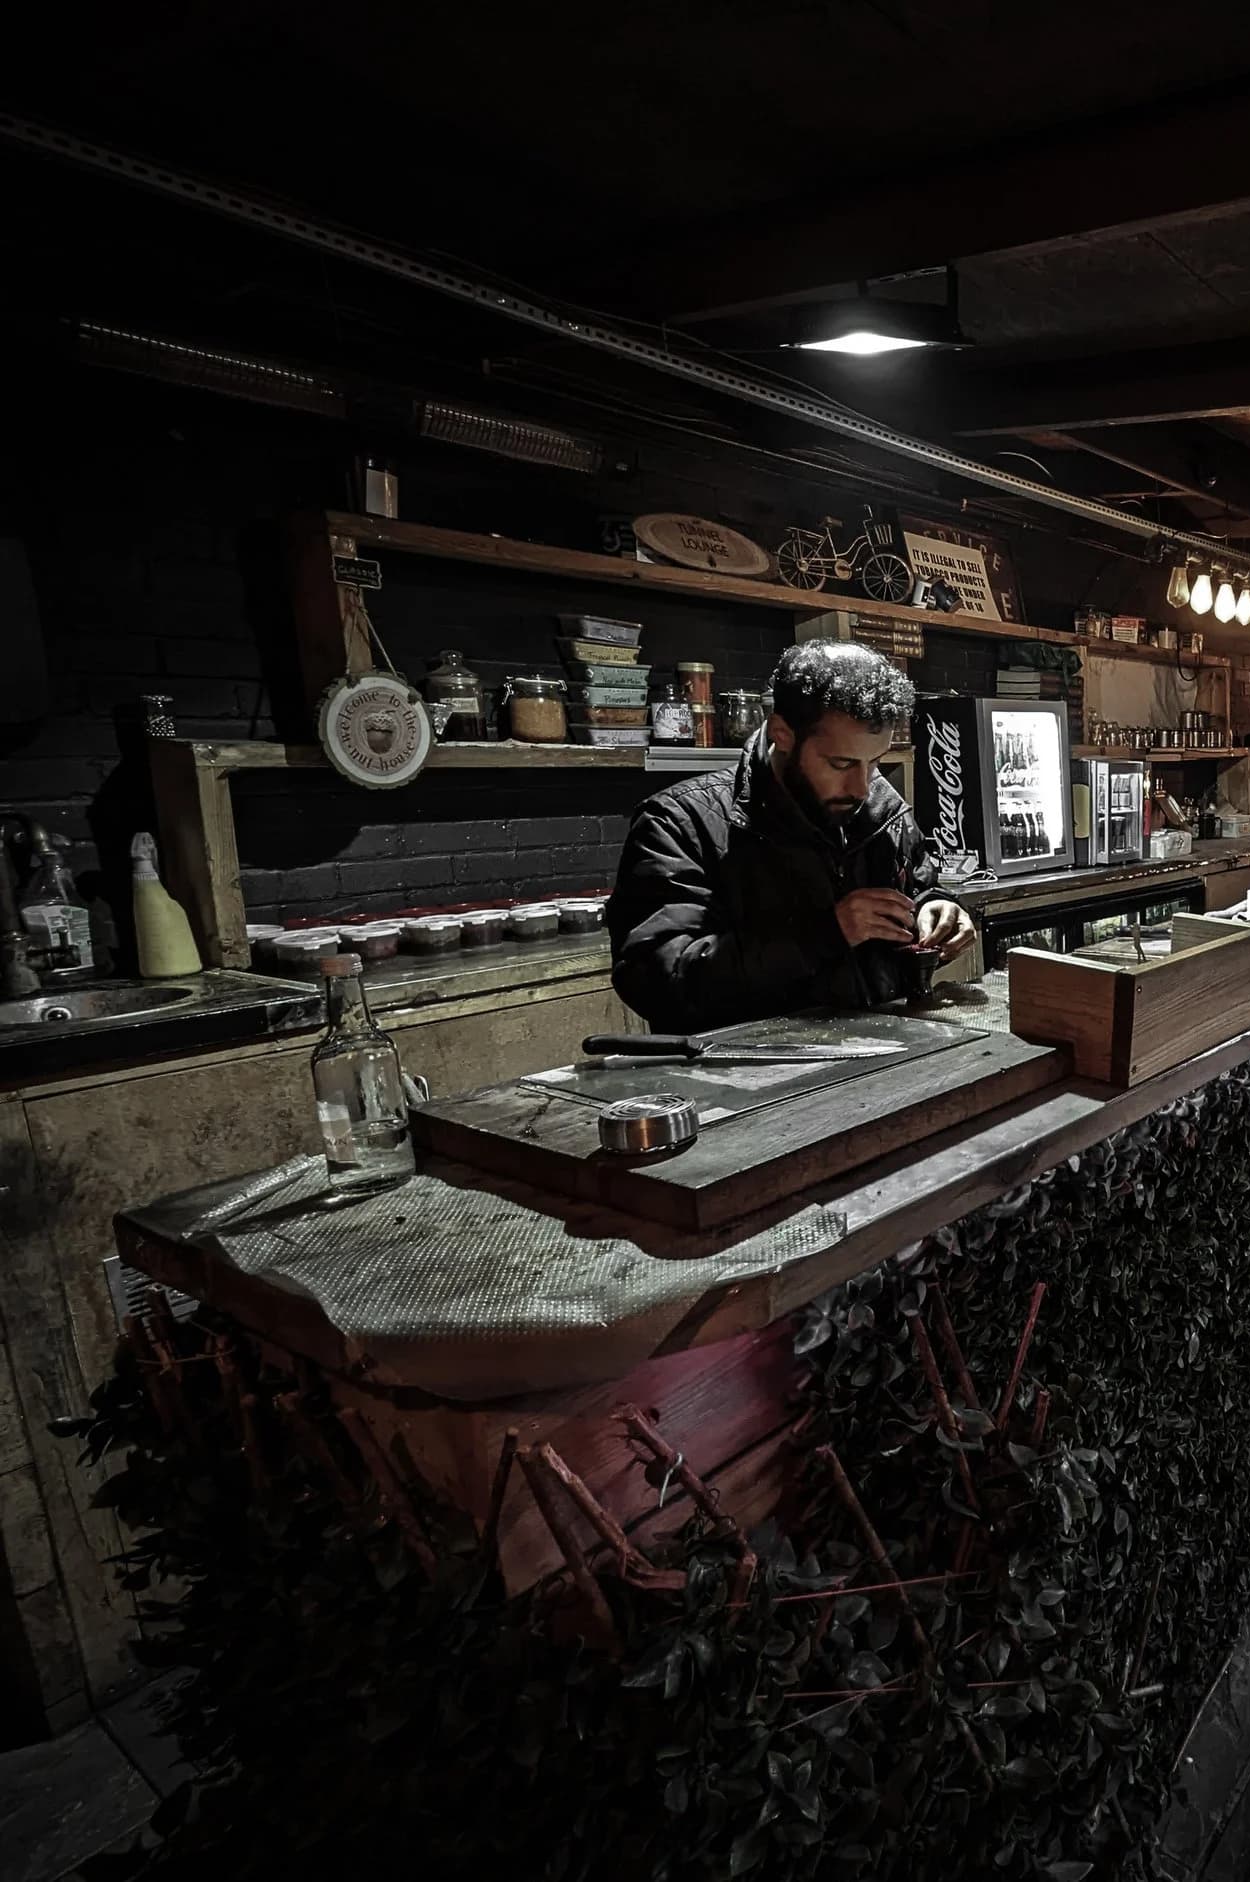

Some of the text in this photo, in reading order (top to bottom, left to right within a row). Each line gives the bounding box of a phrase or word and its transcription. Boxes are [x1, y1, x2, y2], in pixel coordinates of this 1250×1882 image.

[678, 522, 724, 543] TUNNEL
[681, 536, 729, 558] LOUNGE
[912, 549, 982, 574] IT IS ILLEGAL TO SELL
[950, 572, 986, 588] PRODUCTS
[963, 587, 986, 601] UNDER
[965, 601, 975, 611] OF
[338, 690, 417, 743] welcome to the
[926, 712, 964, 859] Coca-Cola
